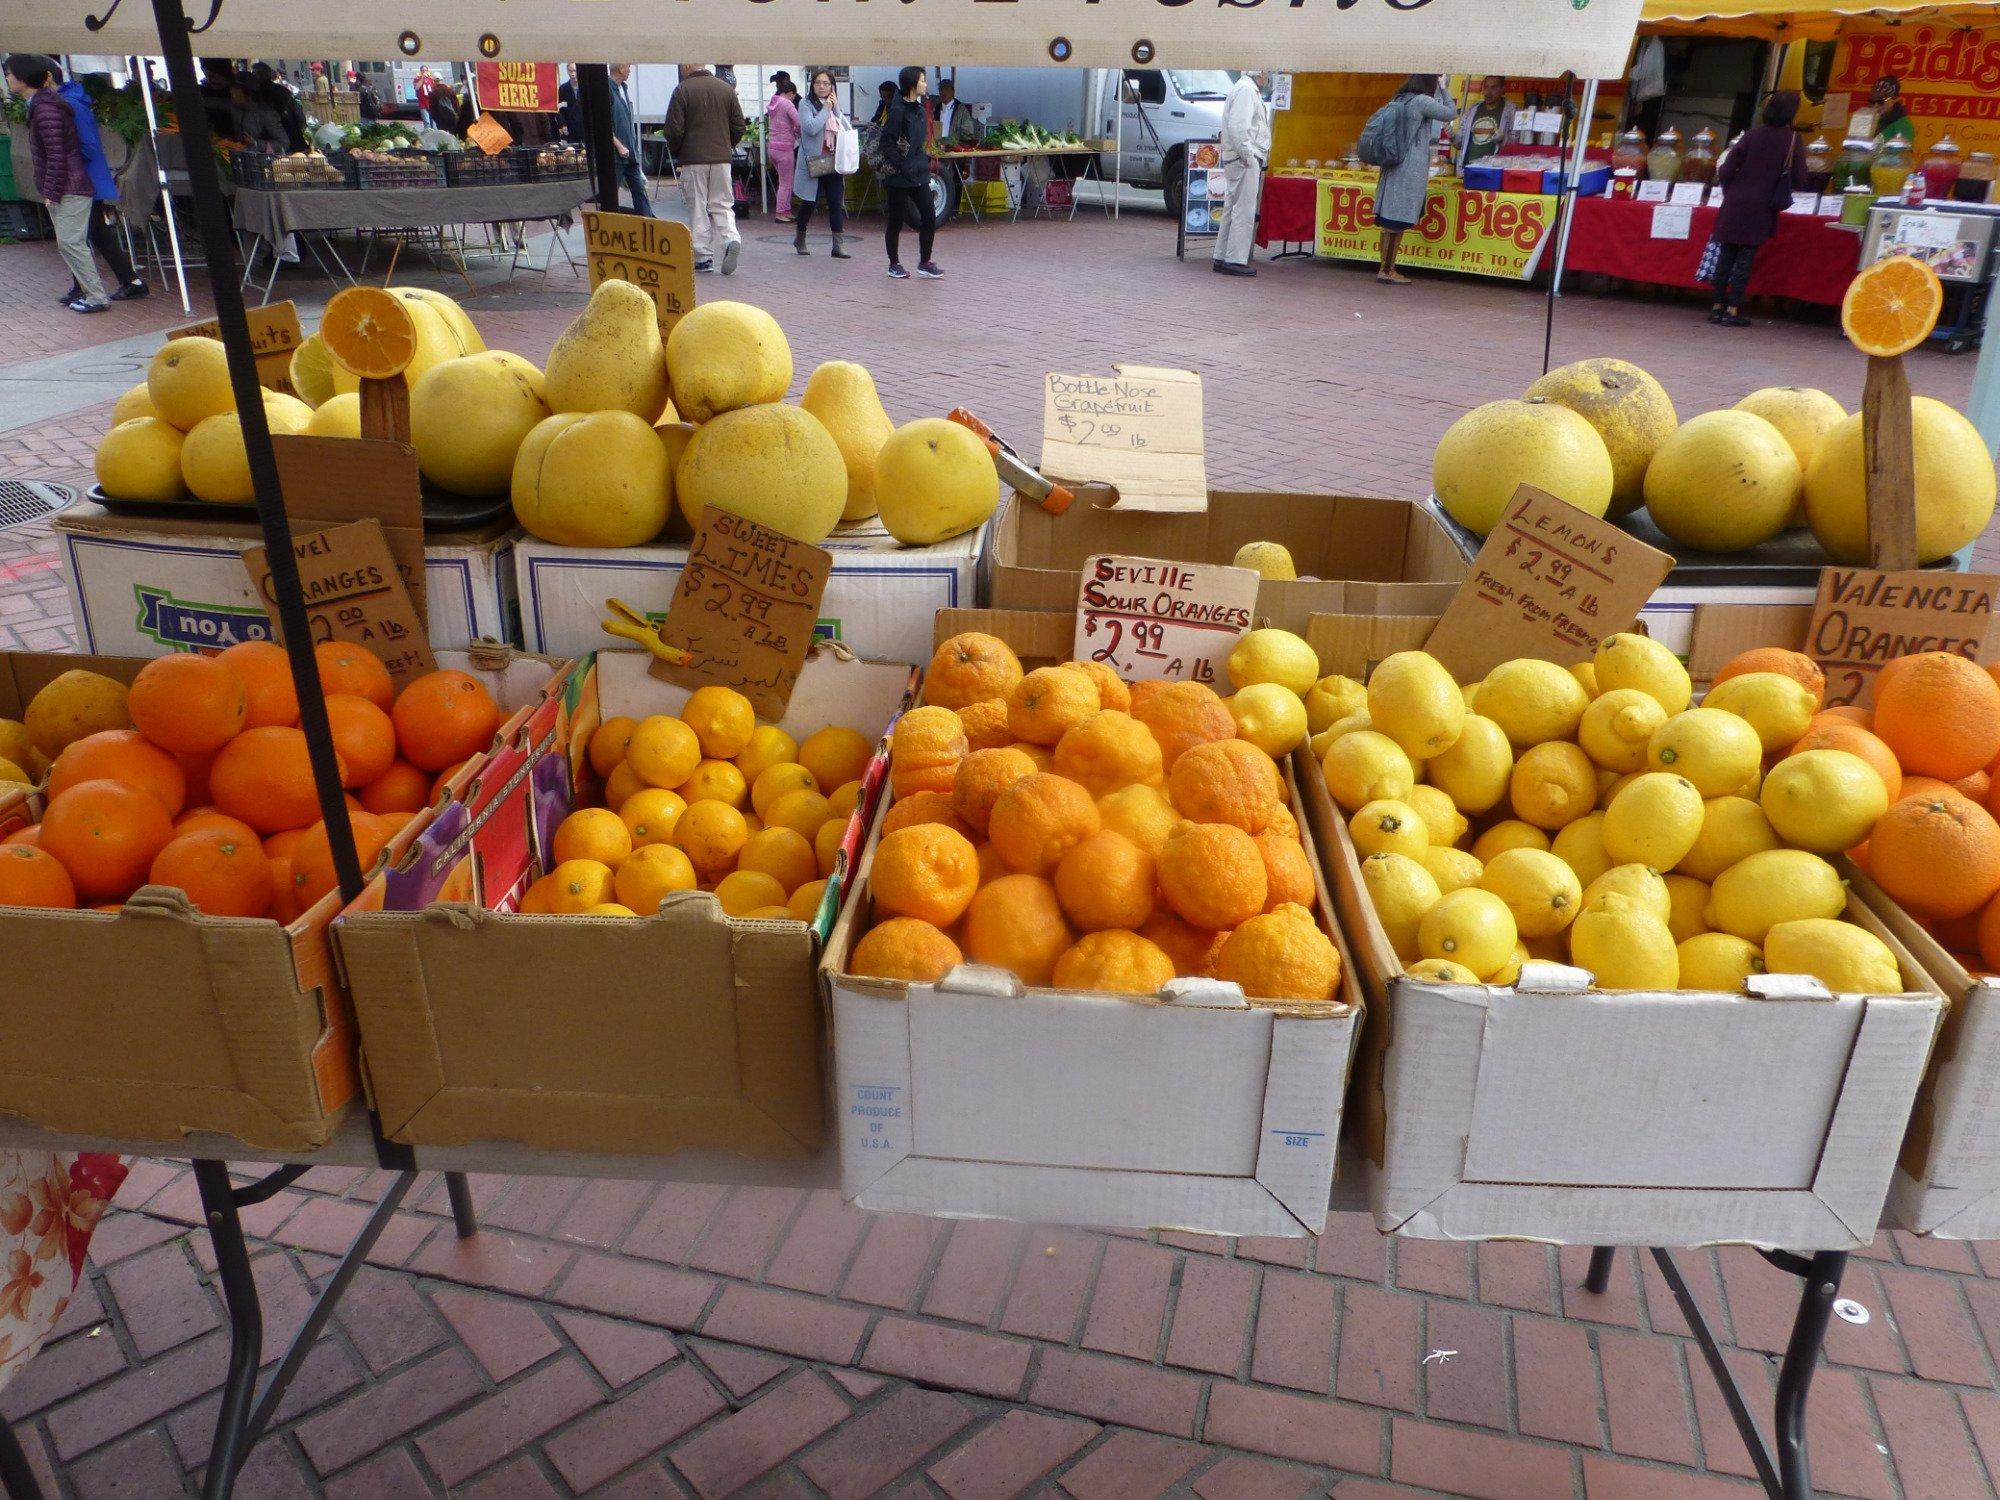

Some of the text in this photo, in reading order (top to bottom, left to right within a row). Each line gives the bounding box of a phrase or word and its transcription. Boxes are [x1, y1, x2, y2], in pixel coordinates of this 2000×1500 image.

[498, 62, 536, 82] SOLD
[498, 83, 539, 108] HERE
[1323, 236, 1367, 251] WHOLE
[1397, 244, 1433, 258] SLICE
[1438, 248, 1456, 260] OF
[1461, 251, 1484, 263] PIE
[1490, 253, 1508, 266] TO
[1053, 393, 1155, 417] Grapefruit
[712, 515, 799, 559] SWEET
[694, 532, 814, 597] LIMES
[1082, 579, 1250, 627] SOUR ORANGES
[1560, 585, 1576, 600] A
[361, 626, 375, 642] A
[1163, 657, 1183, 675] A
[435, 797, 500, 871] CALIFORNIA
[857, 1089, 893, 1101] COUNT
[851, 1106, 901, 1118] PRODUCE
[869, 1123, 884, 1132] OF
